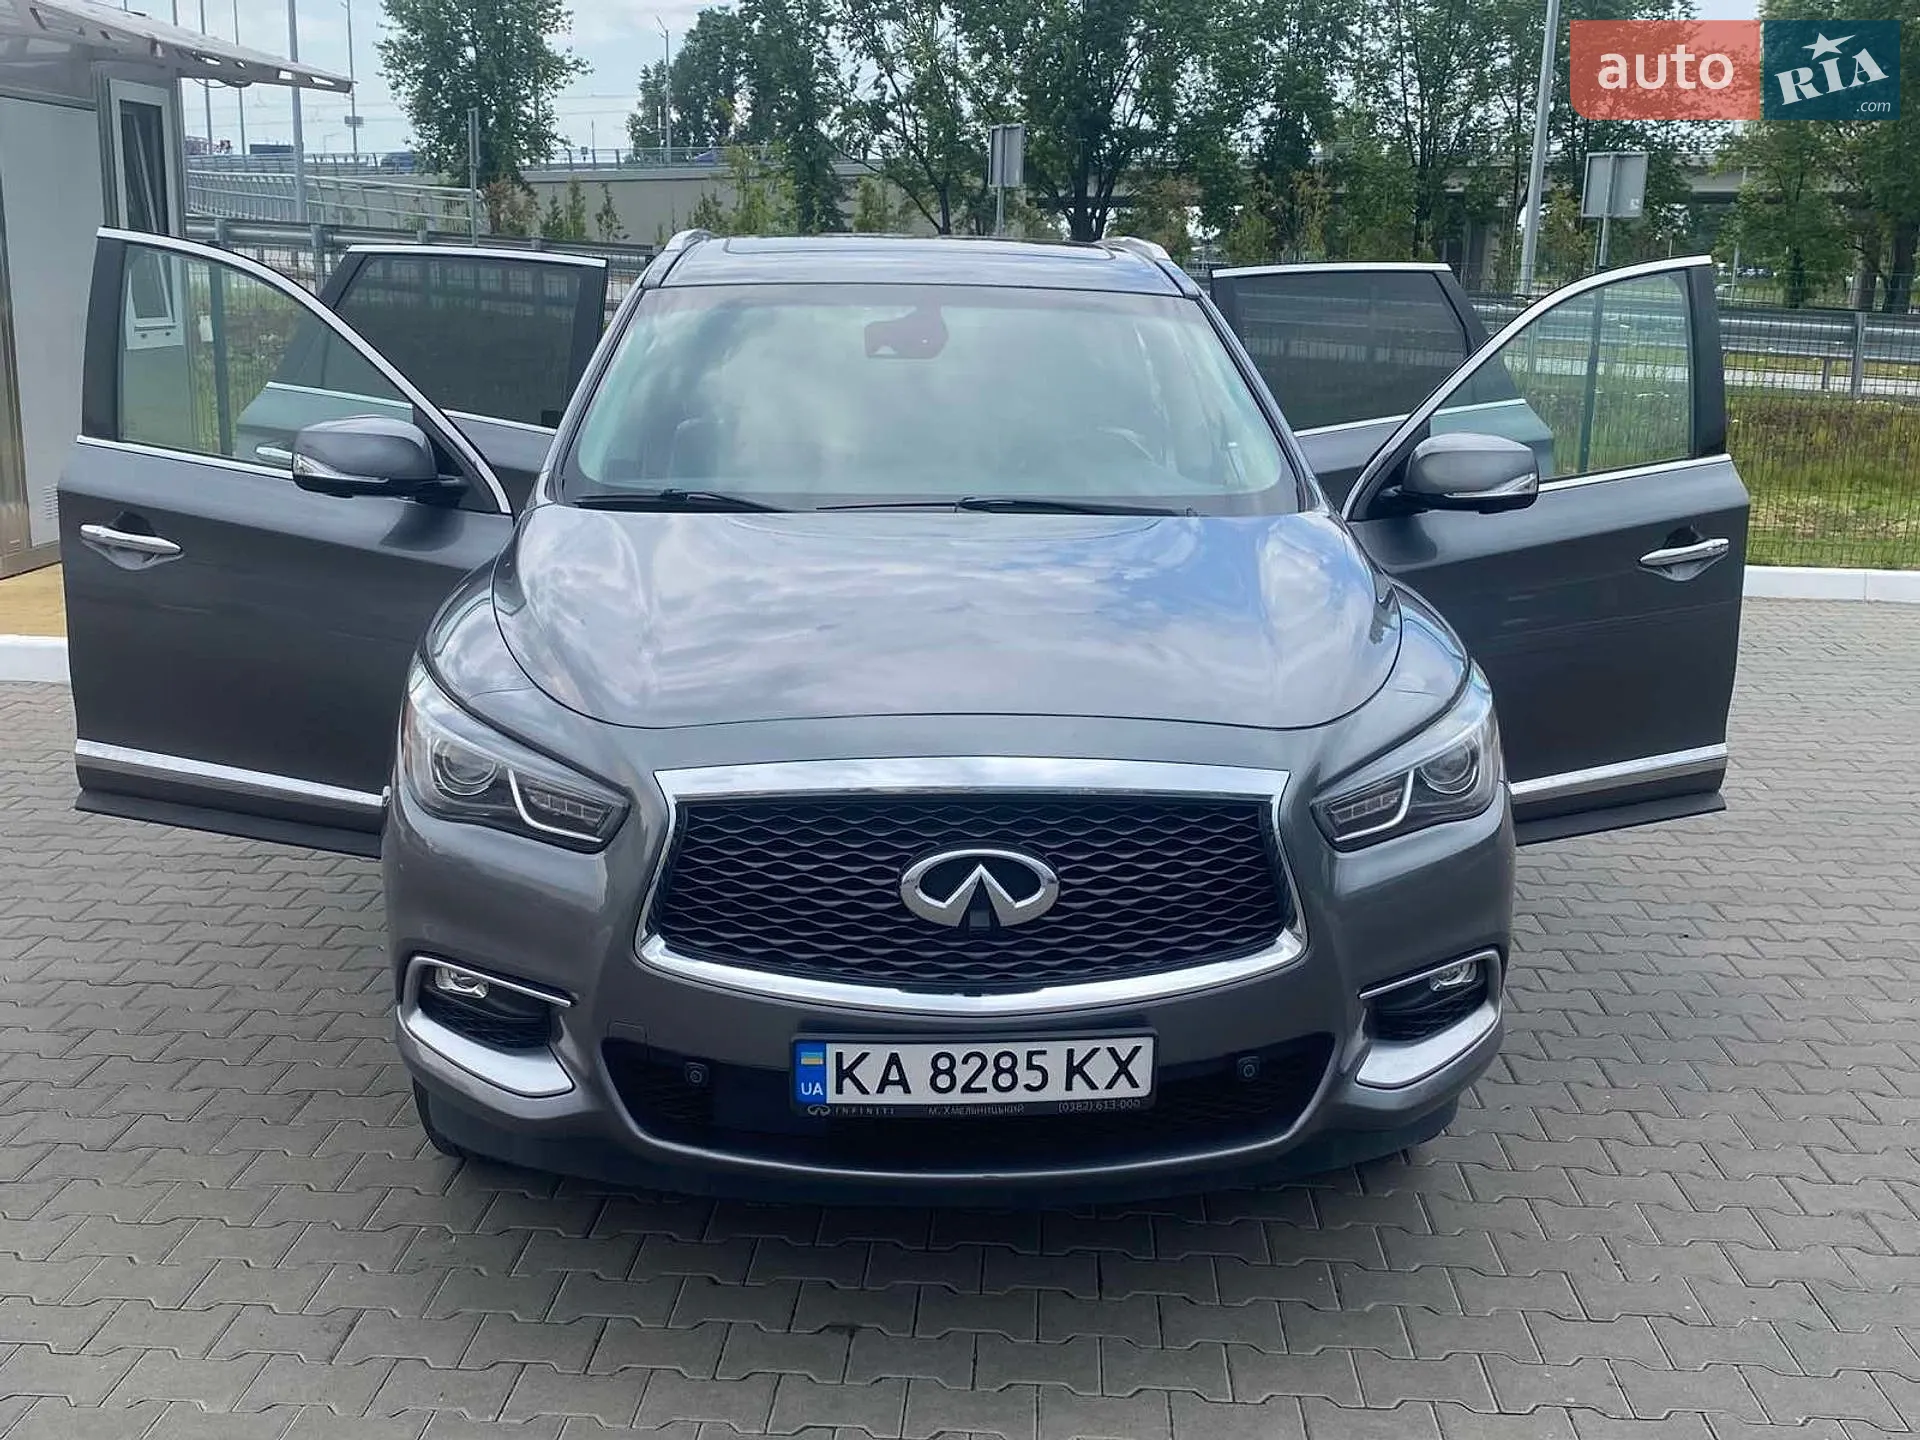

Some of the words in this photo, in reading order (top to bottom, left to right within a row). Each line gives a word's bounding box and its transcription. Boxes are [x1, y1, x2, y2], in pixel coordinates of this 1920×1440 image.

[835, 1051, 912, 1095] KA
[929, 1049, 1049, 1095] 8285
[1065, 1045, 1143, 1092] KX
[801, 1082, 824, 1096] UA
